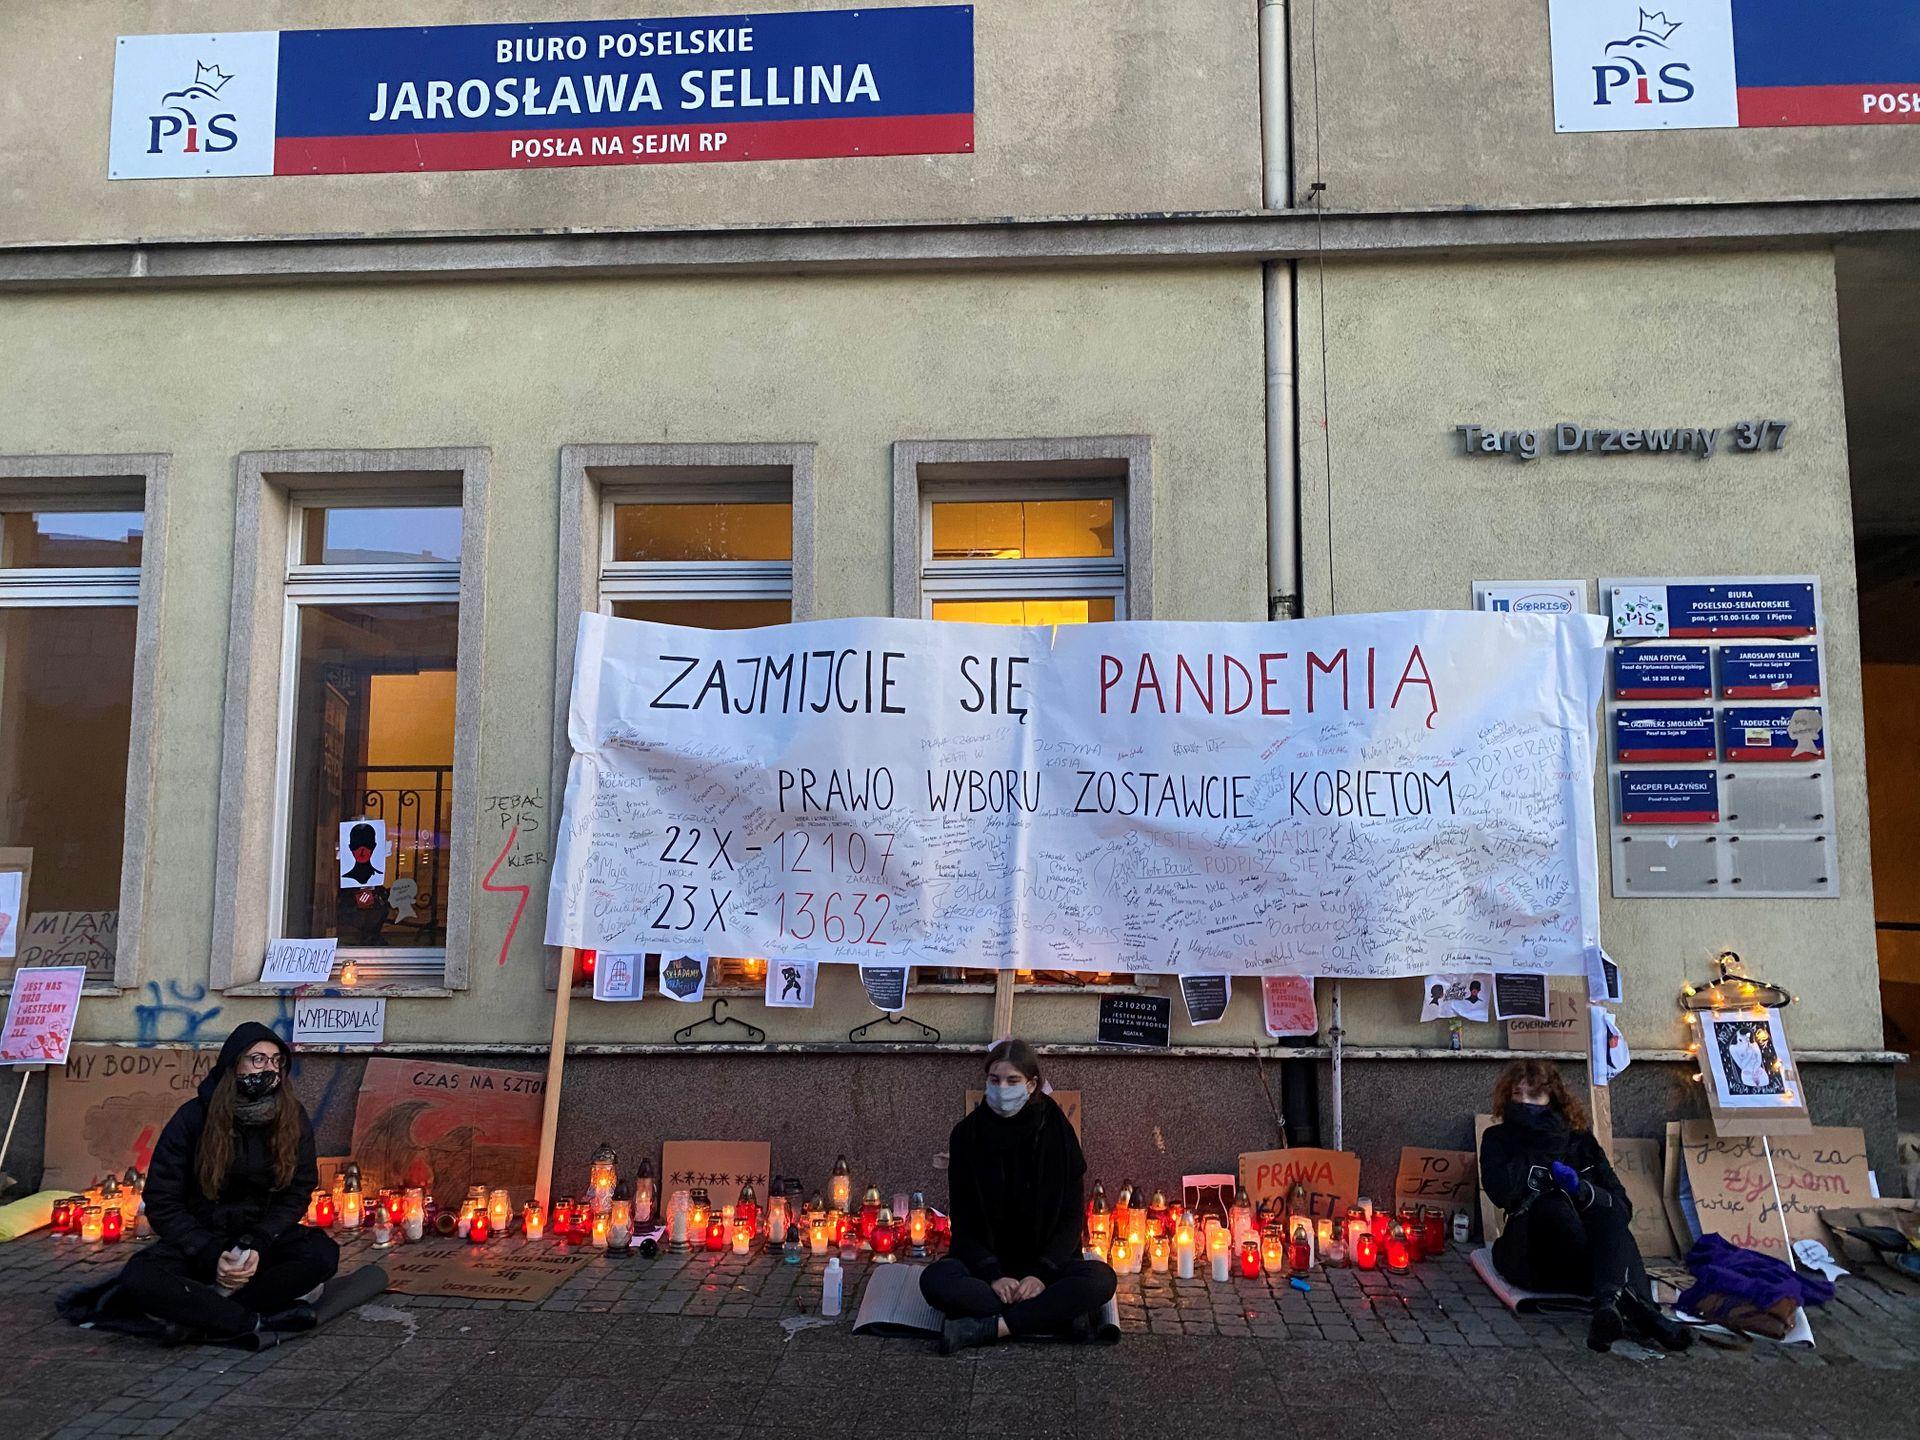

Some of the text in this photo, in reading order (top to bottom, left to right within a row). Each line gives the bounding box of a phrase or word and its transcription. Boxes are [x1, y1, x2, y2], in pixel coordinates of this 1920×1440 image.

[496, 27, 754, 63] BIURO POSELSKIE
[368, 63, 881, 121] JAROSŁAWA SELLINA
[1592, 62, 1695, 105] PiS
[146, 112, 239, 154] PiS
[510, 132, 728, 158] POSŁA NA SEJM RP
[1457, 420, 1792, 459] Targ Drzewny 3/7
[1728, 591, 1753, 599] BIURA
[1516, 602, 1569, 611] SORRISO
[1692, 600, 1791, 610] POSELSKO-SENATORSKIE
[1720, 613, 1760, 622] 10.00-16.00
[650, 645, 1438, 729] ZAJMIJCIE SIĘ PANDEMIĄ
[1033, 738, 1102, 752] JUSTYNA
[778, 766, 894, 813] PRAWO
[927, 769, 1041, 813] WYBORU
[1074, 771, 1253, 819] ZOSTAWCIE
[1290, 769, 1456, 817] KOBIETOM
[1664, 782, 1708, 790] PŁAŻYŃSKI
[484, 788, 544, 812] JEBAĆ
[501, 811, 539, 832] PIS
[508, 852, 547, 867] KLER
[1205, 856, 1277, 875] PODPISZ
[1332, 944, 1361, 963] OLA
[23, 981, 43, 992] JEST
[22, 1002, 67, 1015] JESTEŚMY
[298, 1001, 380, 1030] WYPIERDALAĆ
[1135, 1020, 1168, 1029] WYBOREM
[1510, 1019, 1579, 1031] GOVERNMENT
[65, 1054, 96, 1079] MY
[169, 1073, 204, 1091] CHO
[412, 1071, 460, 1089] CZAS
[470, 1075, 494, 1090] NA
[1420, 1156, 1450, 1174] TO
[1814, 1149, 1854, 1164] za
[1256, 1160, 1335, 1192] PRAWA
[1402, 1175, 1470, 1196] JEST
[1254, 1191, 1341, 1219] KOET
[1696, 1193, 1745, 1214] więc
